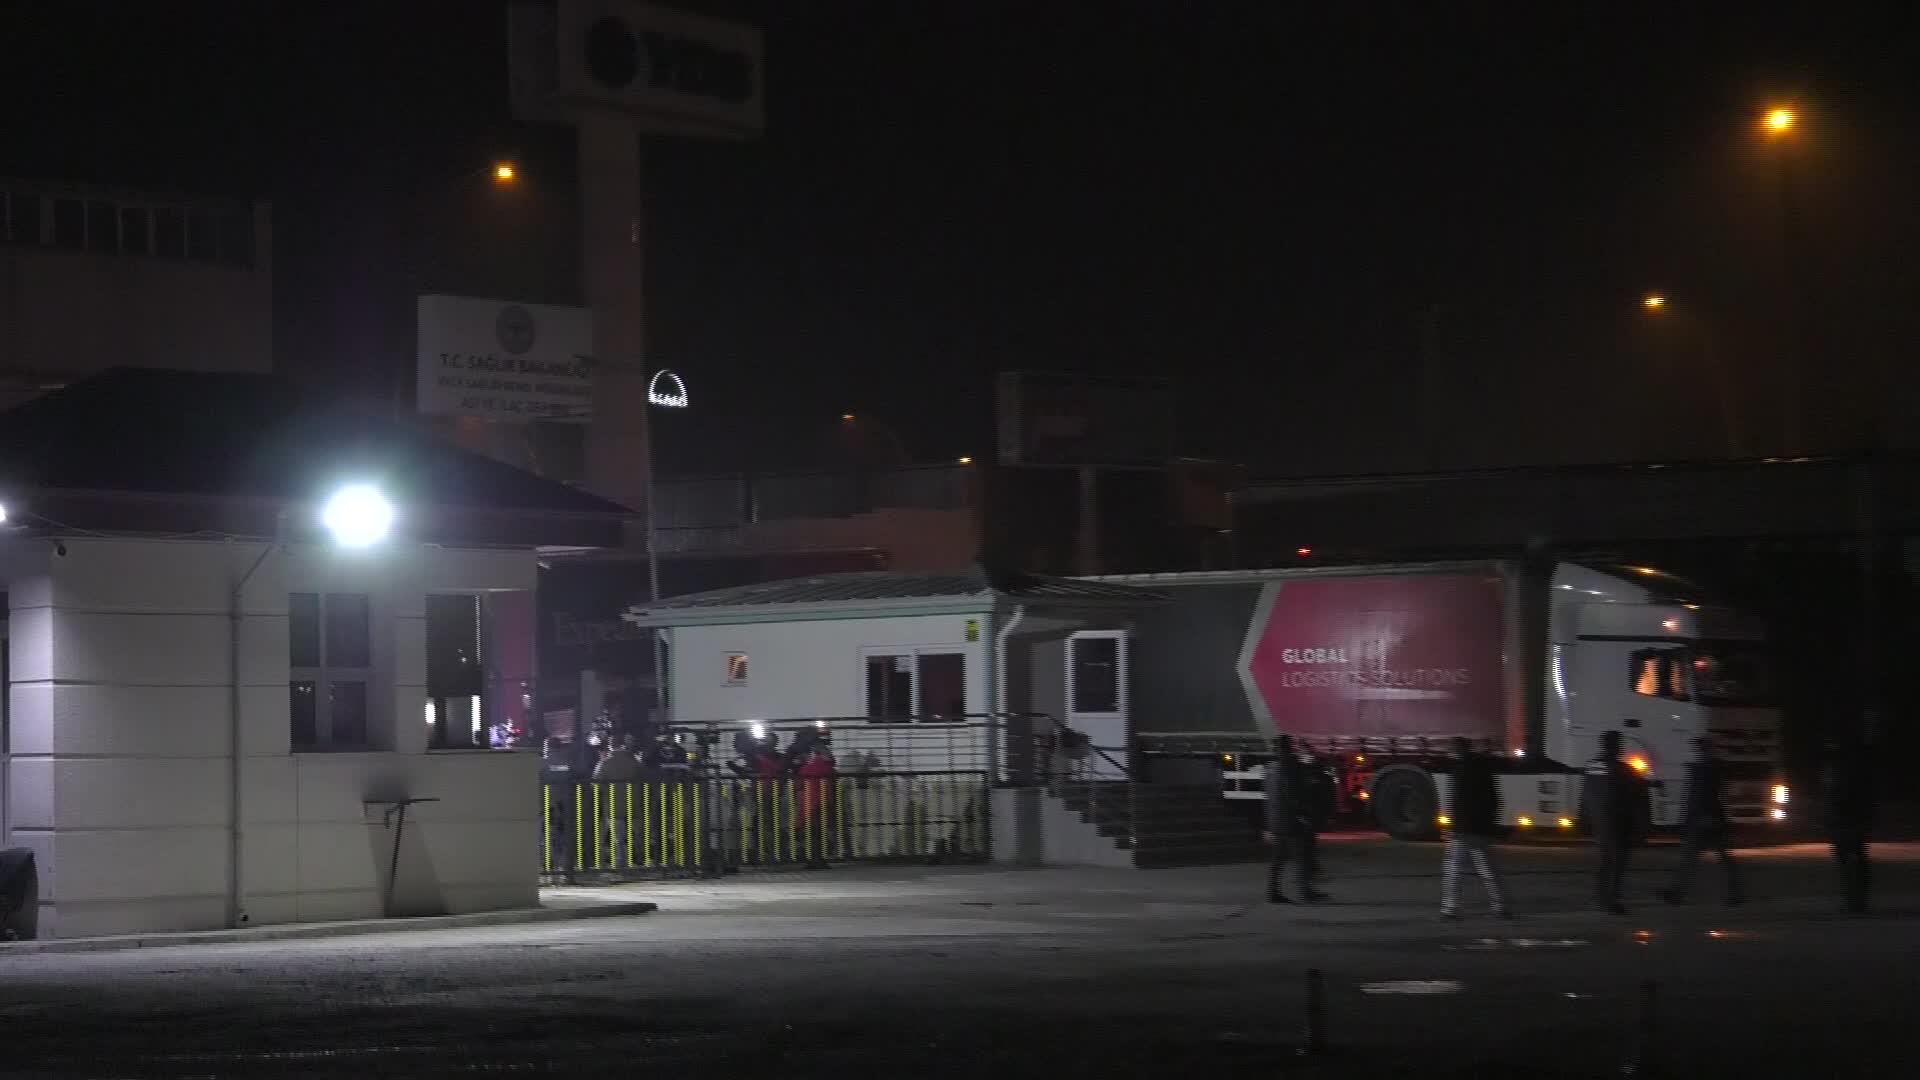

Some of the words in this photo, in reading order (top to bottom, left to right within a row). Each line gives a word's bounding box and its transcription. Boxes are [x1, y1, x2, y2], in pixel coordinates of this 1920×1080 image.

[1281, 648, 1349, 664] GLOBAL
[1281, 670, 1368, 688] LOGISTICS
[1370, 668, 1469, 687] SOLUTIONS
